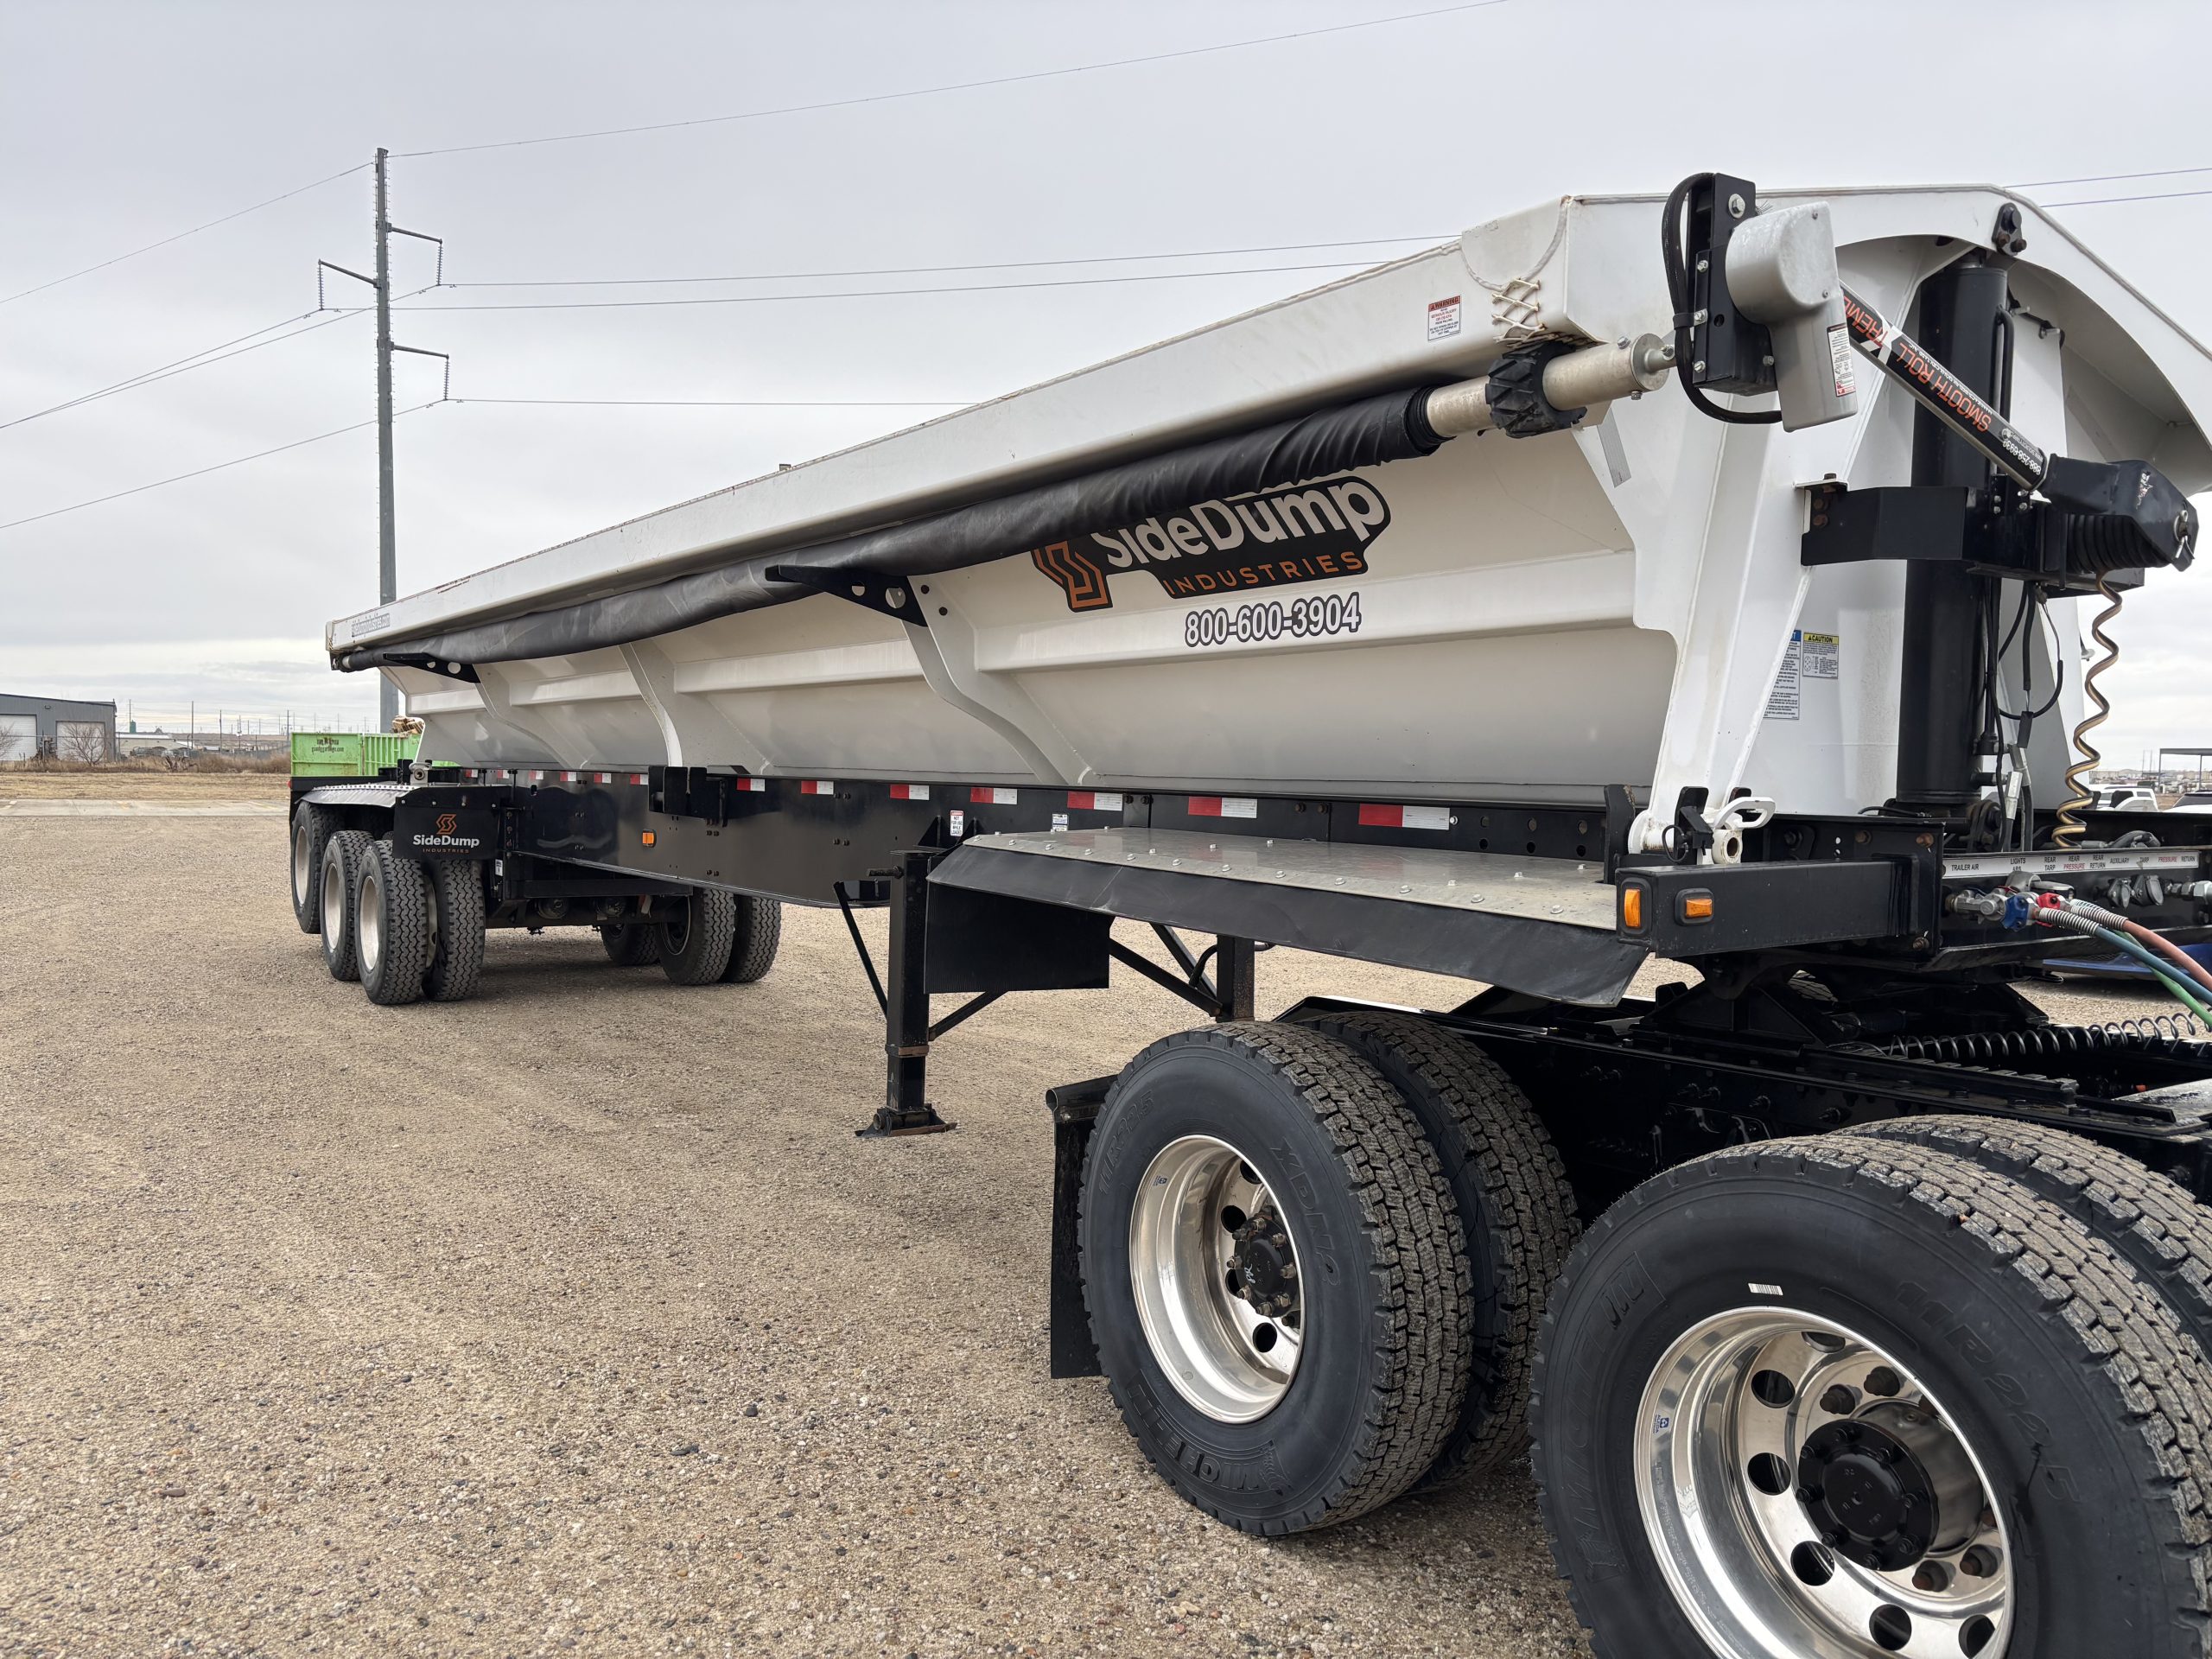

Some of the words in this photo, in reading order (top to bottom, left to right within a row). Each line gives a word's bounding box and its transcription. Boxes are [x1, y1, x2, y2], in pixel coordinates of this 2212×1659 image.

[1897, 342, 1935, 384] ROLL
[1930, 375, 1992, 432] SMOOTH
[1091, 481, 1386, 569] SideDump
[1163, 551, 1363, 595] INDUSTRIES
[1185, 591, 1362, 647] 800-600-3904
[1811, 634, 1833, 643] CAUTION
[413, 834, 480, 848] SideDump
[1561, 1255, 1645, 1530] MICHELIN
[1128, 1374, 1261, 1493] MICHELIN
